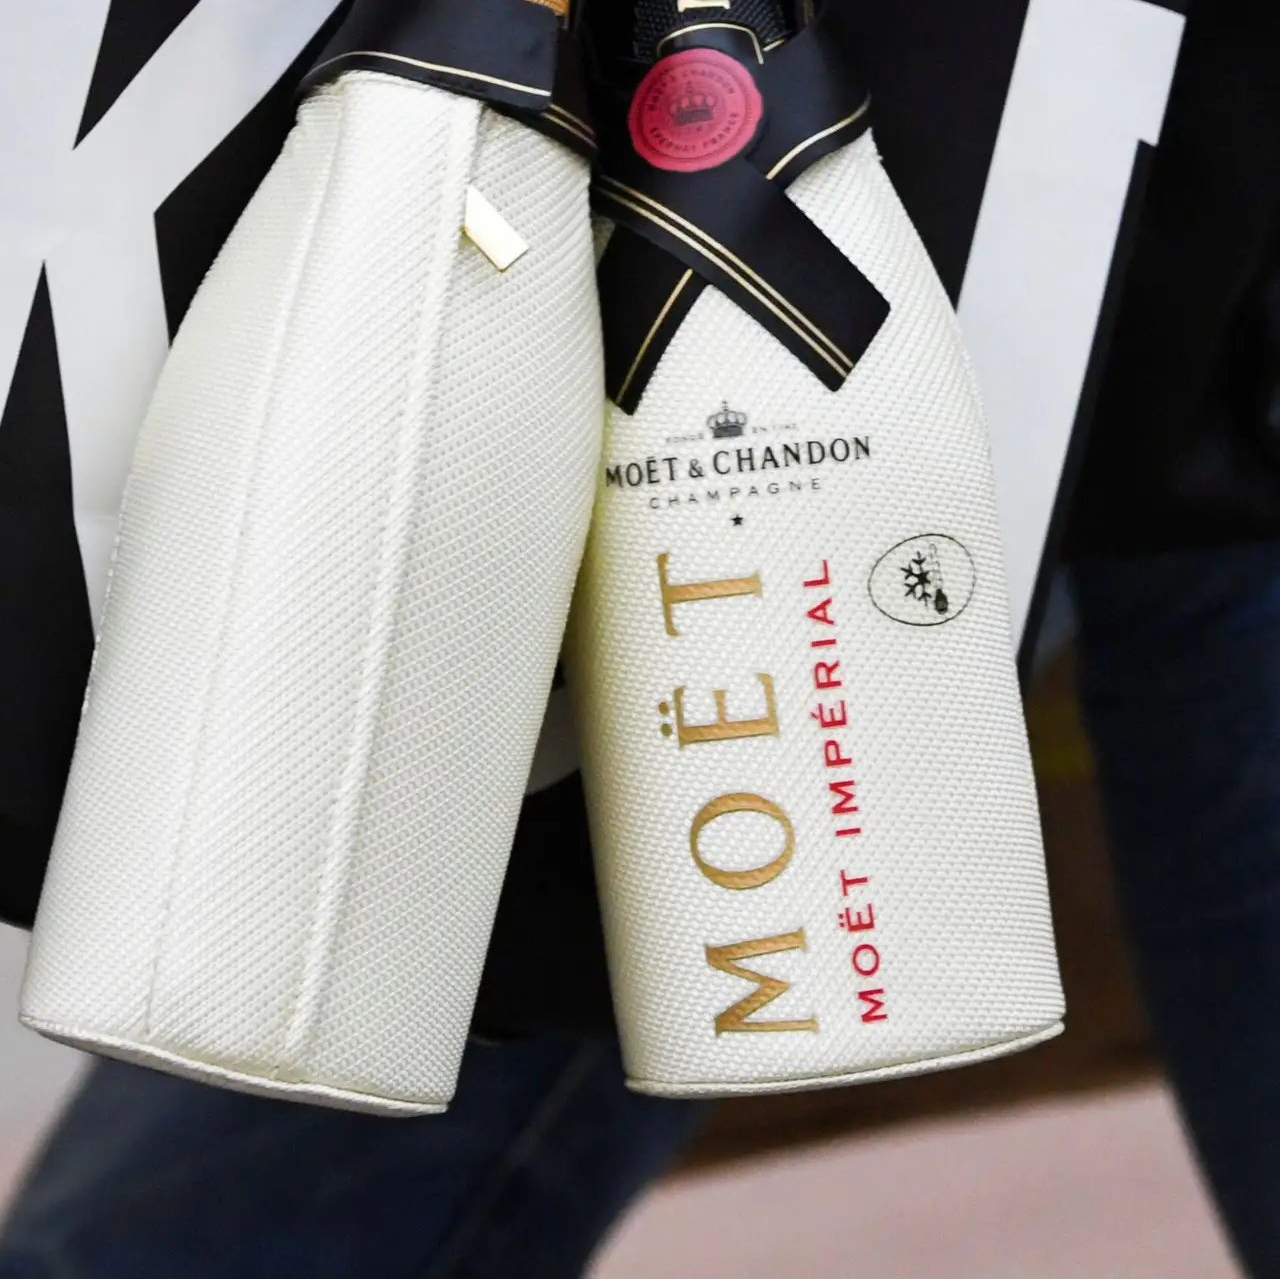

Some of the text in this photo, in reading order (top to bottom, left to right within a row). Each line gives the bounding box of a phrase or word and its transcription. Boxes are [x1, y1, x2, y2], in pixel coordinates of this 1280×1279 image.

[648, 478, 823, 511] CHAMPAGNE
[687, 459, 706, 480] &
[712, 435, 871, 476] CHANDON
[656, 551, 819, 1038] MOËT
[802, 558, 888, 1025] MOËT IMPÉRIAL
